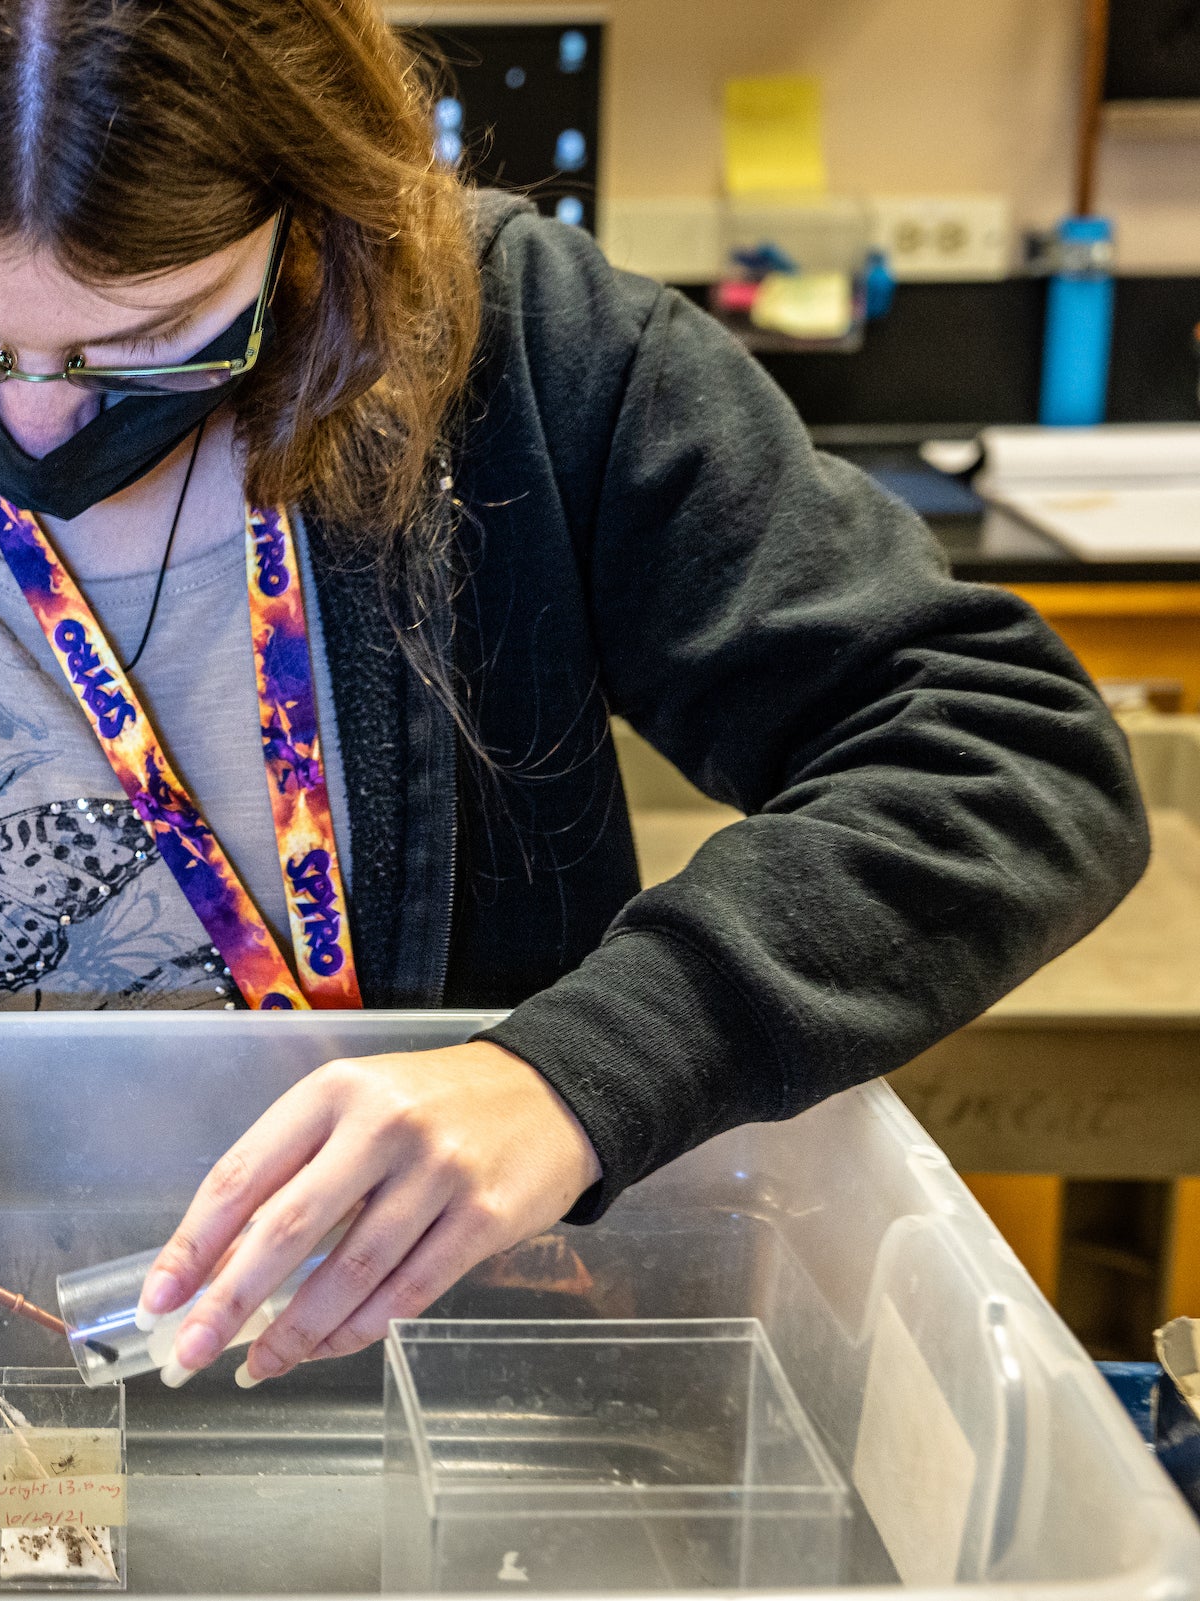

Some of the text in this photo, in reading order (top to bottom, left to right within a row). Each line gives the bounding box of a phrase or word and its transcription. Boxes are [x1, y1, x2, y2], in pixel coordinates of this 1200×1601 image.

[249, 505, 290, 597] YRO
[54, 618, 137, 740] SPYRO
[286, 849, 345, 977] SPYRO
[5, 1509, 84, 1526] 10/29/21
